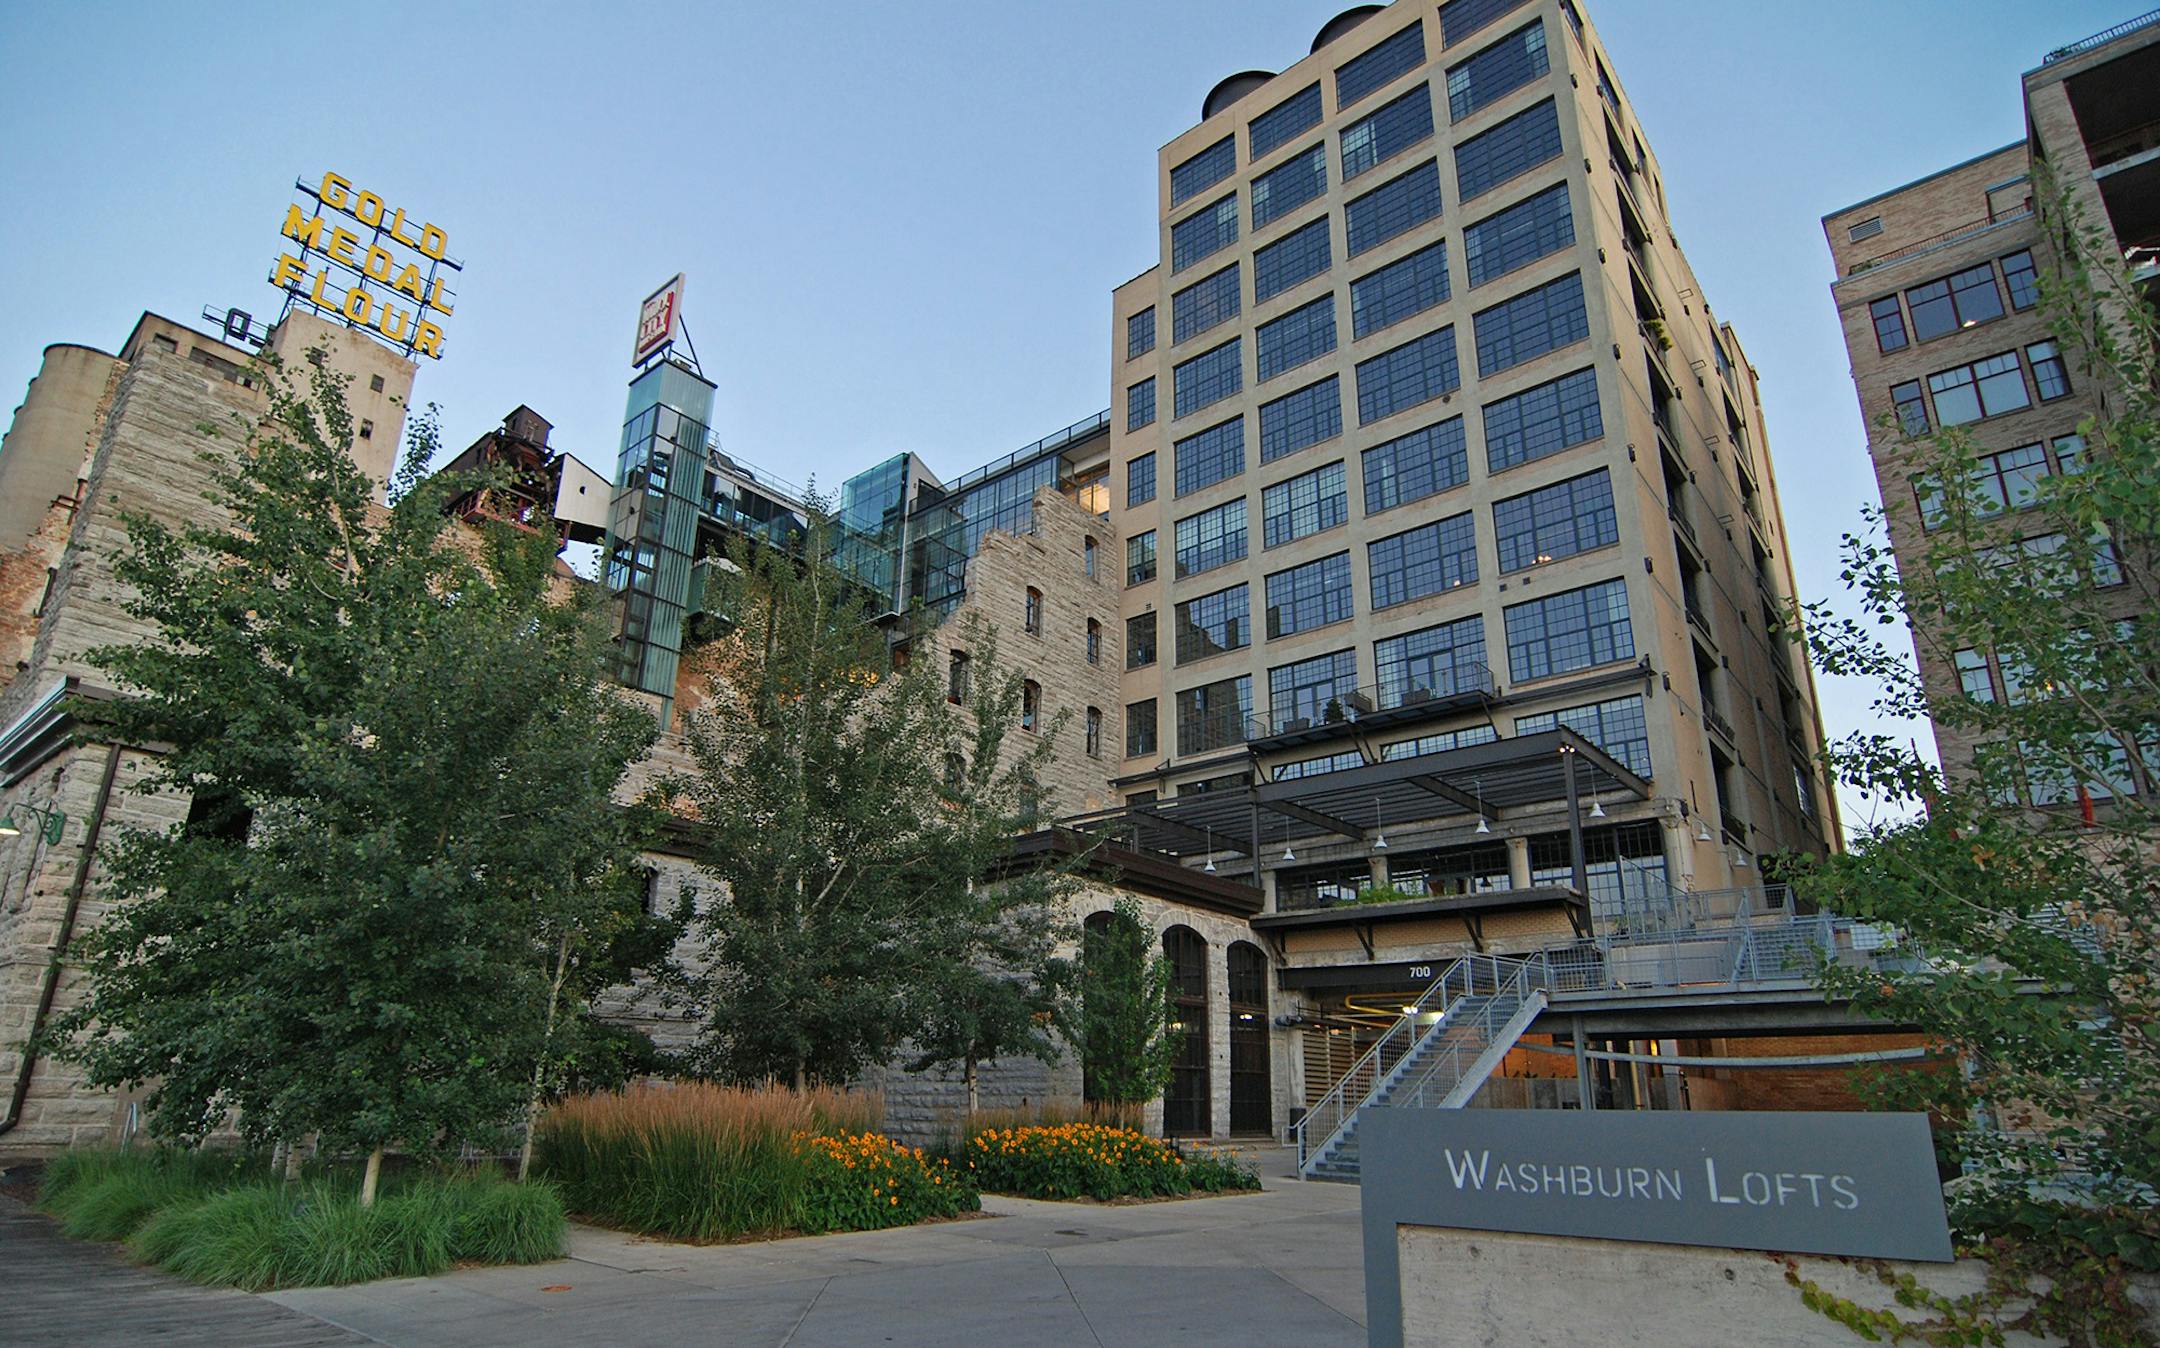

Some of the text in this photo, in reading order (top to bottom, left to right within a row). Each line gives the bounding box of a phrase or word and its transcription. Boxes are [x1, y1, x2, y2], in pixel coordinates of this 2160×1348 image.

[282, 203, 454, 317] MEDAL
[319, 171, 448, 261] GOLD
[273, 252, 444, 359] FLOUR
[1409, 966, 1431, 978] 700
[1444, 1148, 1859, 1210] WASHBURN LOFTS
